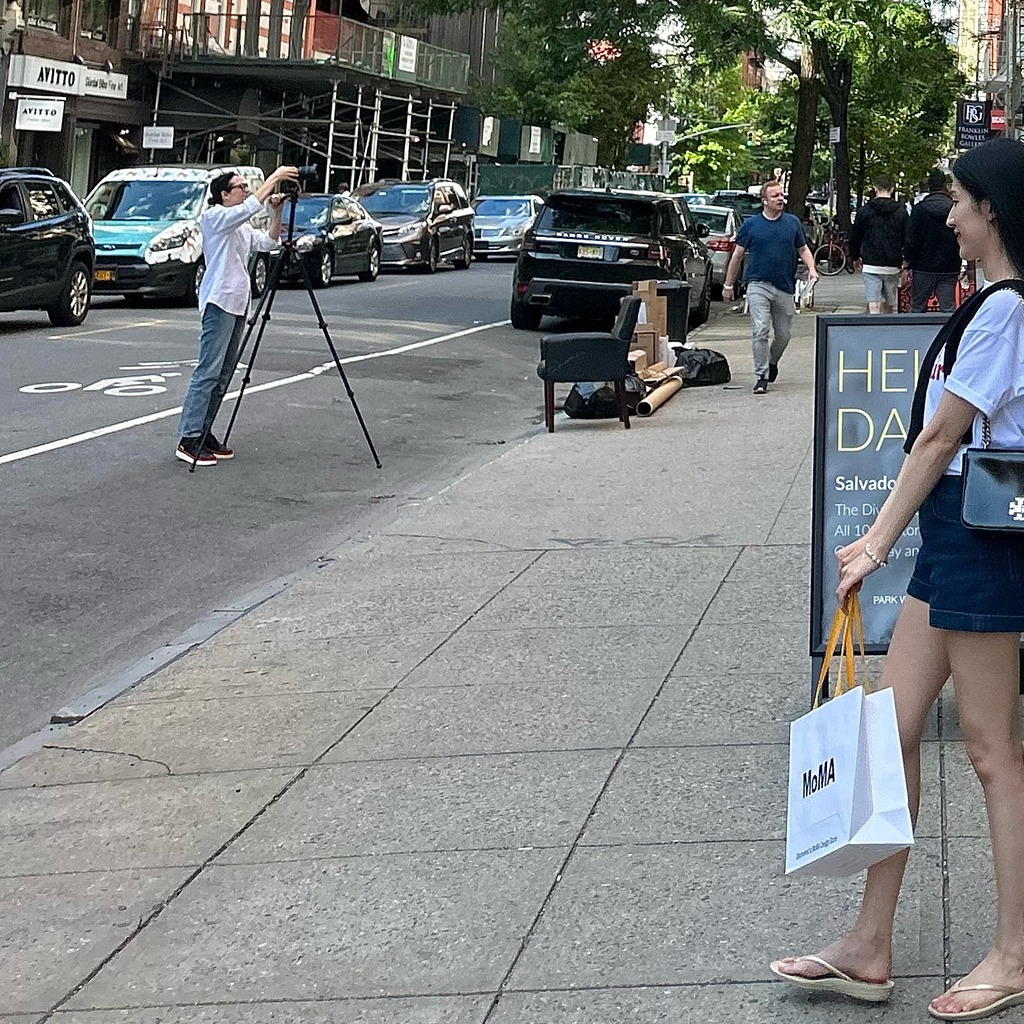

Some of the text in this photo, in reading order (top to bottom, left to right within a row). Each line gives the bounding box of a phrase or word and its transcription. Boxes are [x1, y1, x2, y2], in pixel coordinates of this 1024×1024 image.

[37, 66, 76, 87] AVITTO
[22, 107, 57, 117] AVITTO
[958, 126, 989, 134] FRANKLIN
[835, 503, 859, 516] The
[834, 524, 850, 537] All
[873, 595, 898, 605] PARK
[803, 757, 836, 799] MoMA
